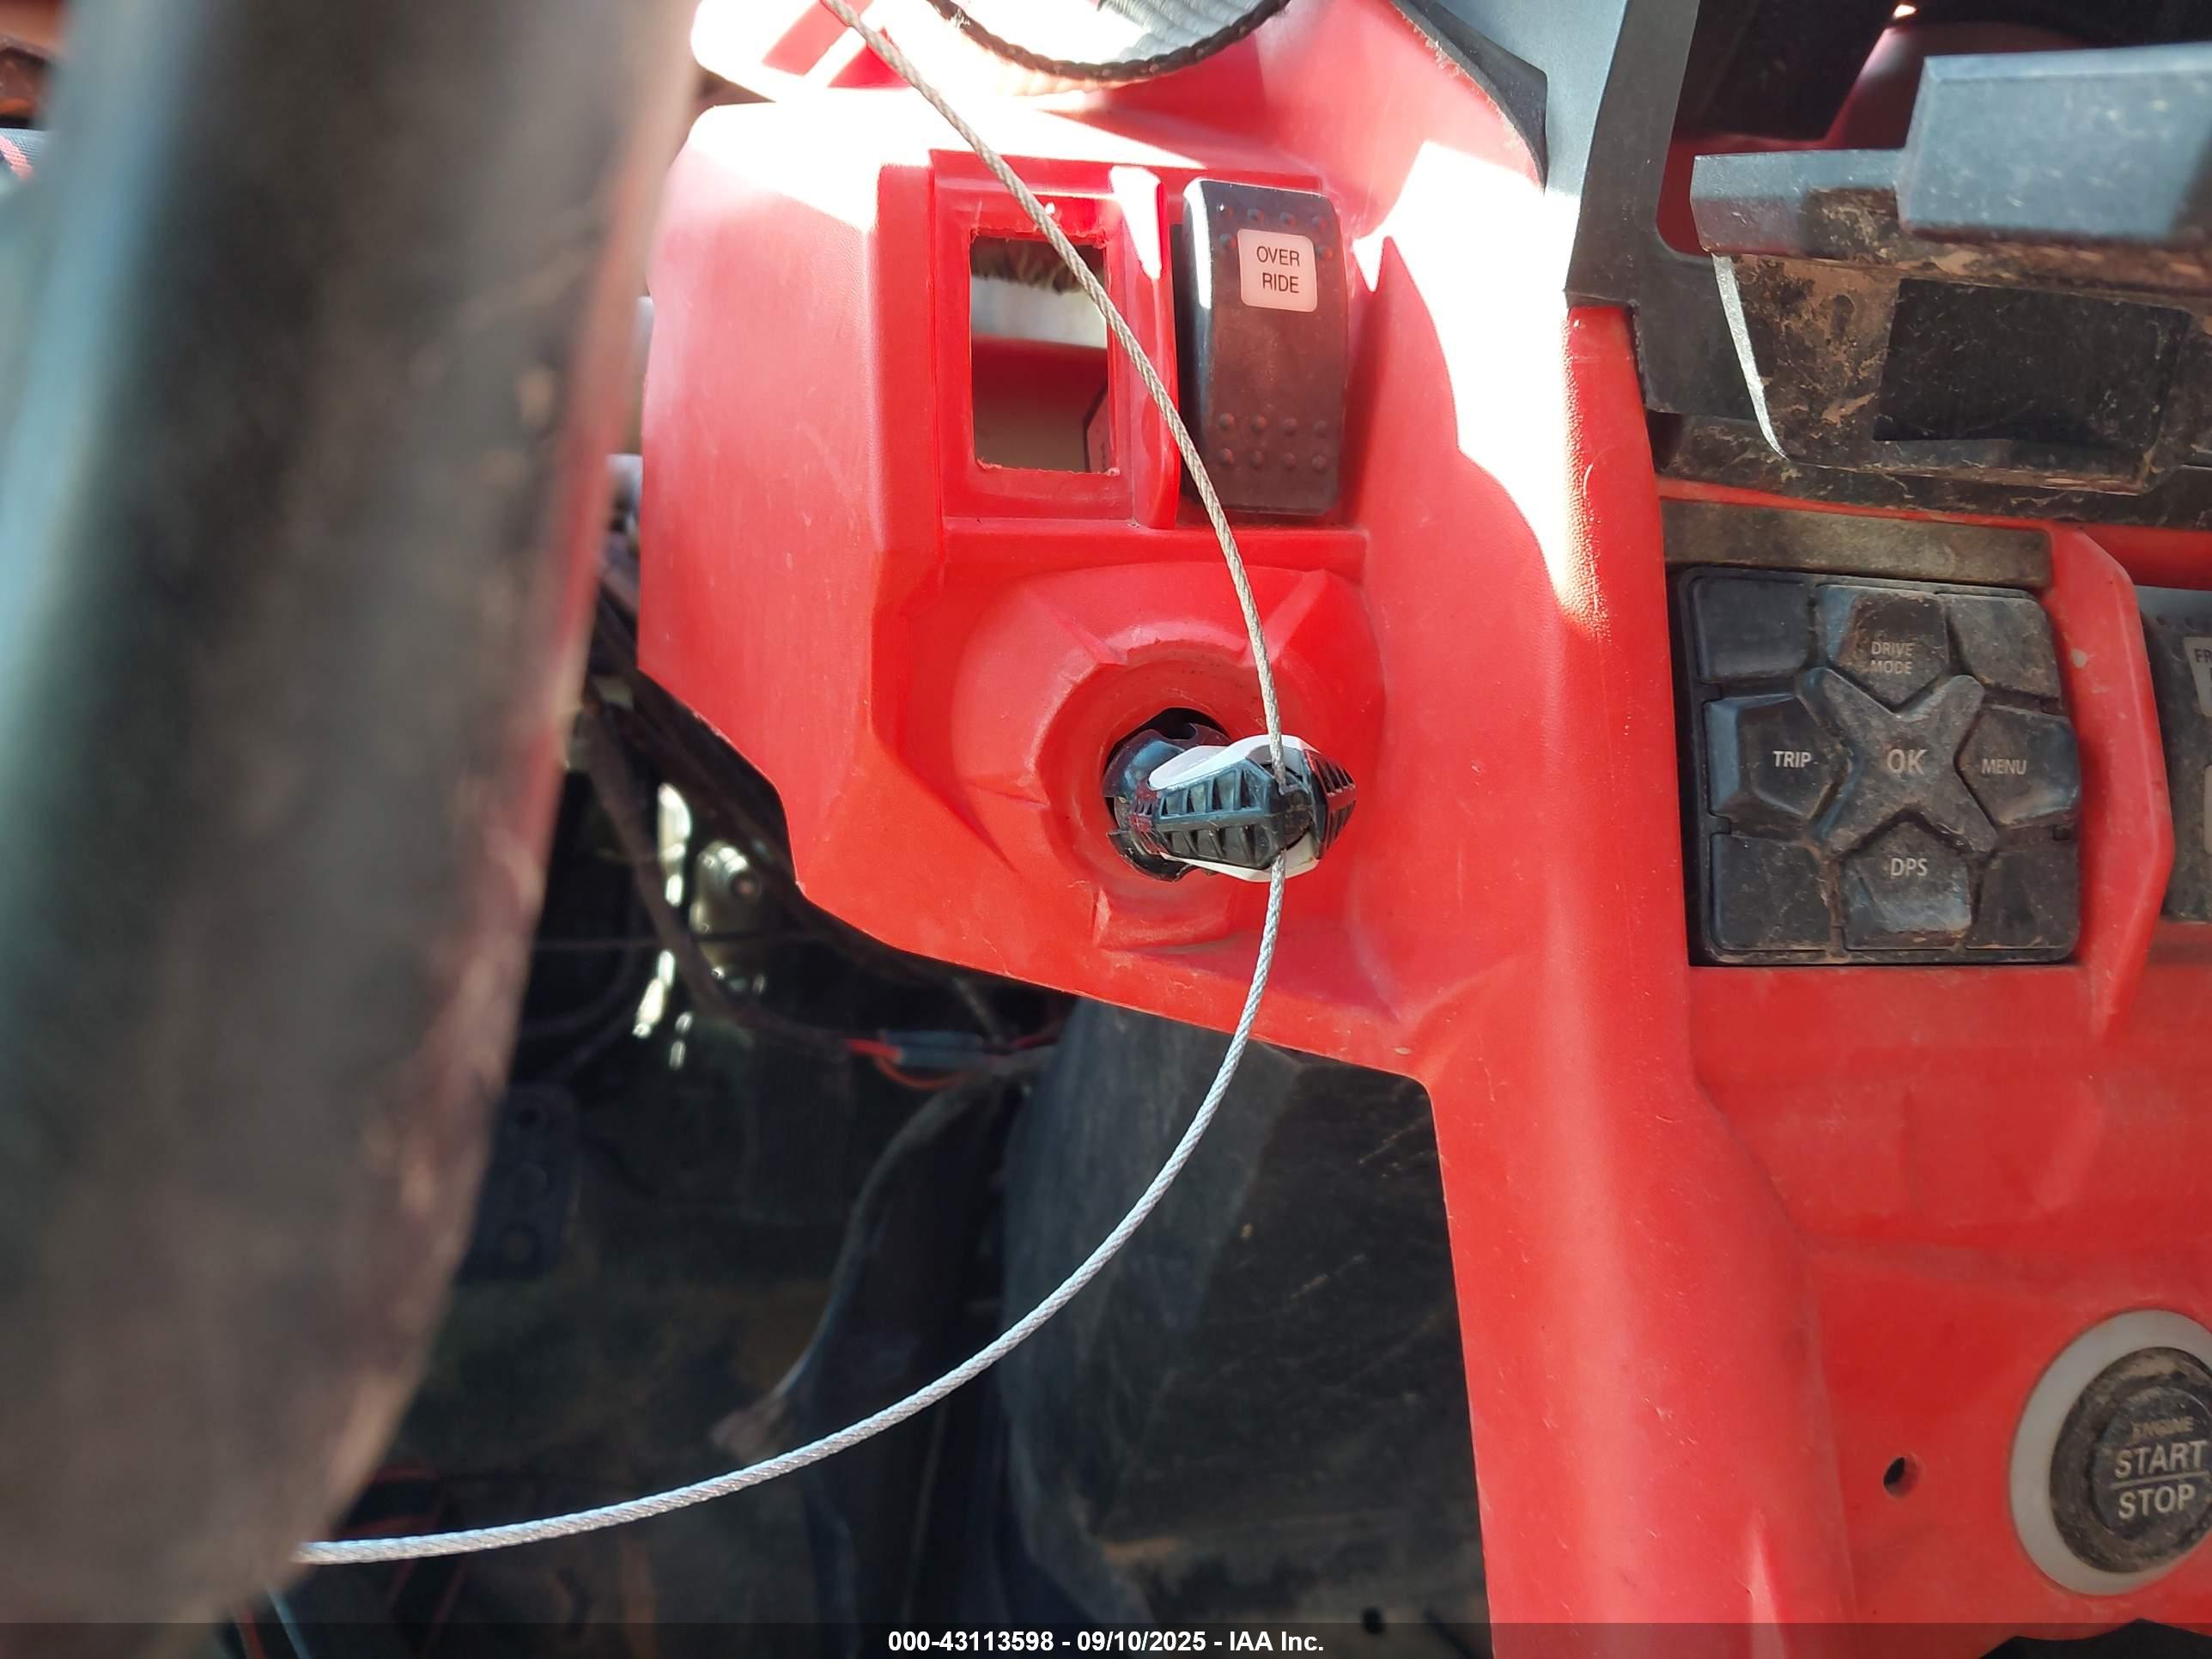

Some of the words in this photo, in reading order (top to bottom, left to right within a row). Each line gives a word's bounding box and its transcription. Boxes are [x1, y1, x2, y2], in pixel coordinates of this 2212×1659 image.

[1256, 246, 1300, 267] OVER
[1261, 271, 1299, 294] RIDE
[1872, 641, 1914, 656] DRIVE
[1870, 660, 1911, 675] MODE
[1772, 750, 1812, 768] TRIP
[1887, 748, 1928, 775] OK
[1981, 758, 2027, 775] MENU
[1891, 858, 1928, 877] DPS
[2114, 1440, 2208, 1479] START
[2118, 1483, 2196, 1520] STOP
